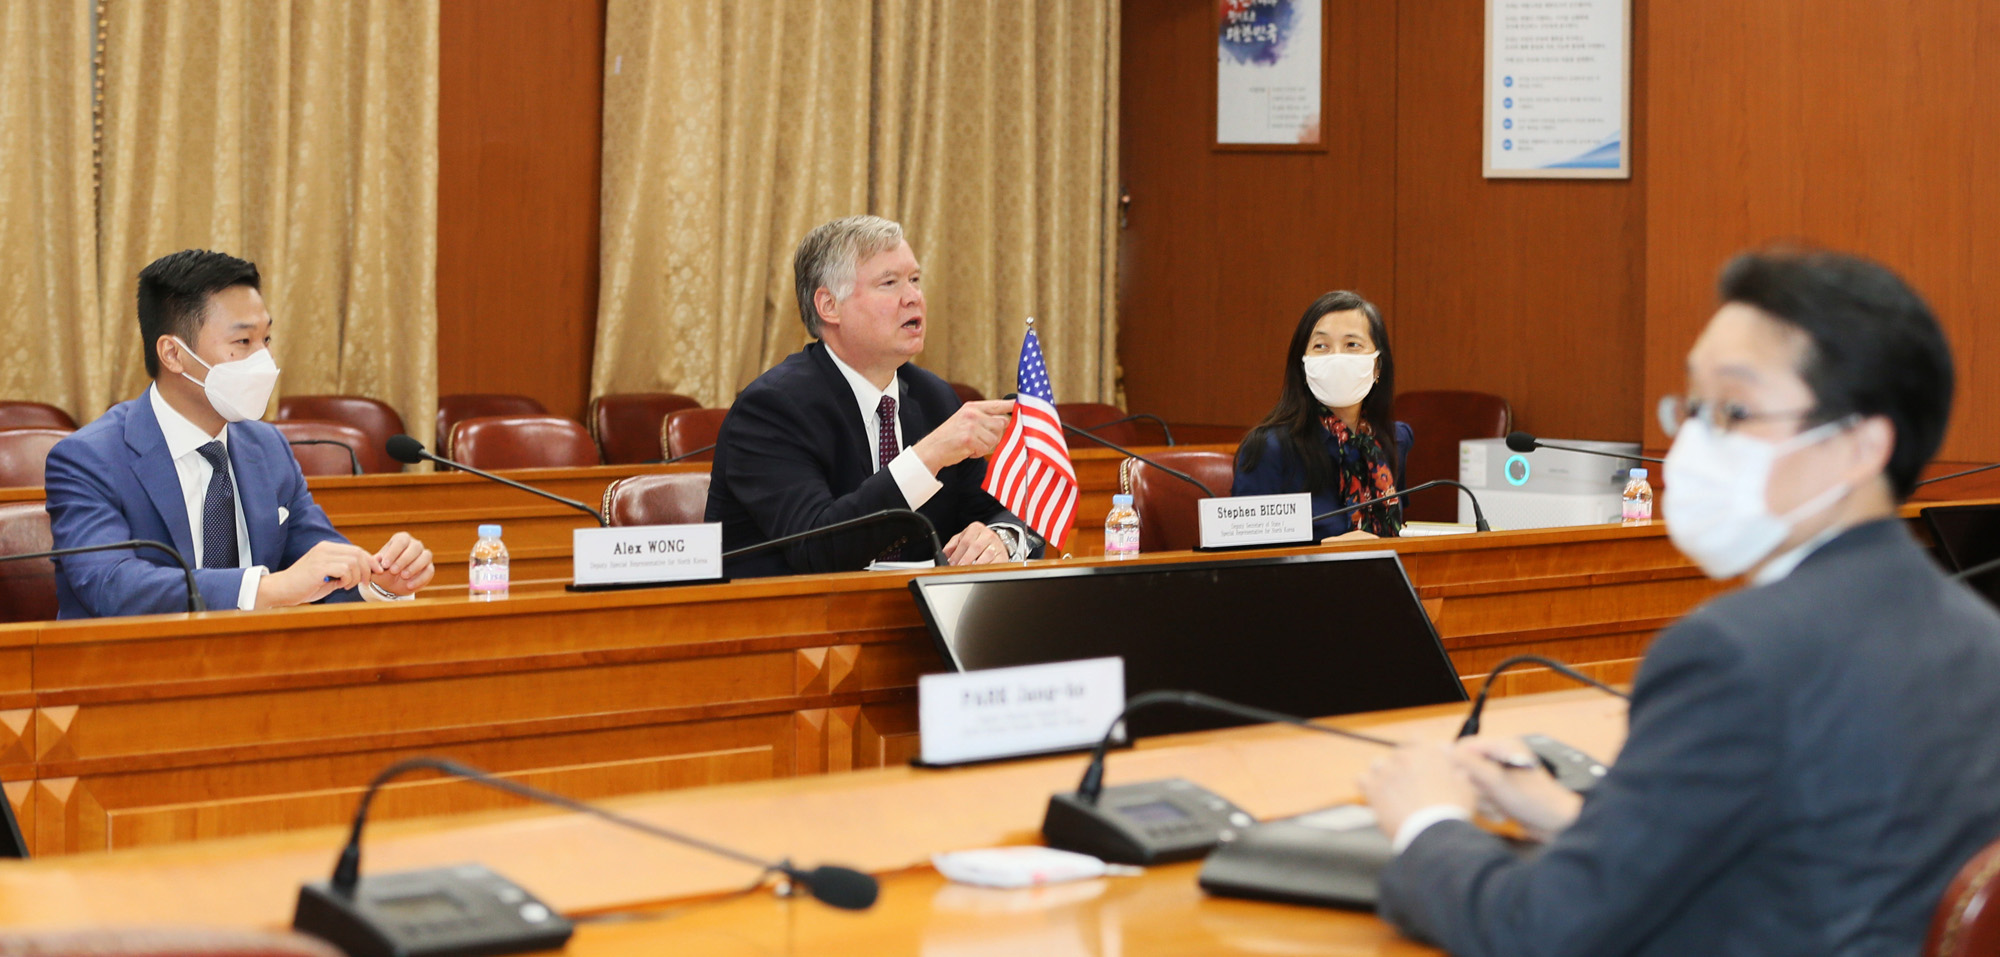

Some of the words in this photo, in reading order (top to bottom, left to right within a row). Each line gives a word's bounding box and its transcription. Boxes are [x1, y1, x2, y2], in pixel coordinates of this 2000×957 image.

[1226, 23, 1278, 44] 대한민국
[1217, 506, 1256, 519] Stephen
[1260, 503, 1297, 516] BIEGUN
[613, 542, 642, 555] Alex
[648, 539, 685, 553] WONG
[630, 558, 666, 568] Representative
